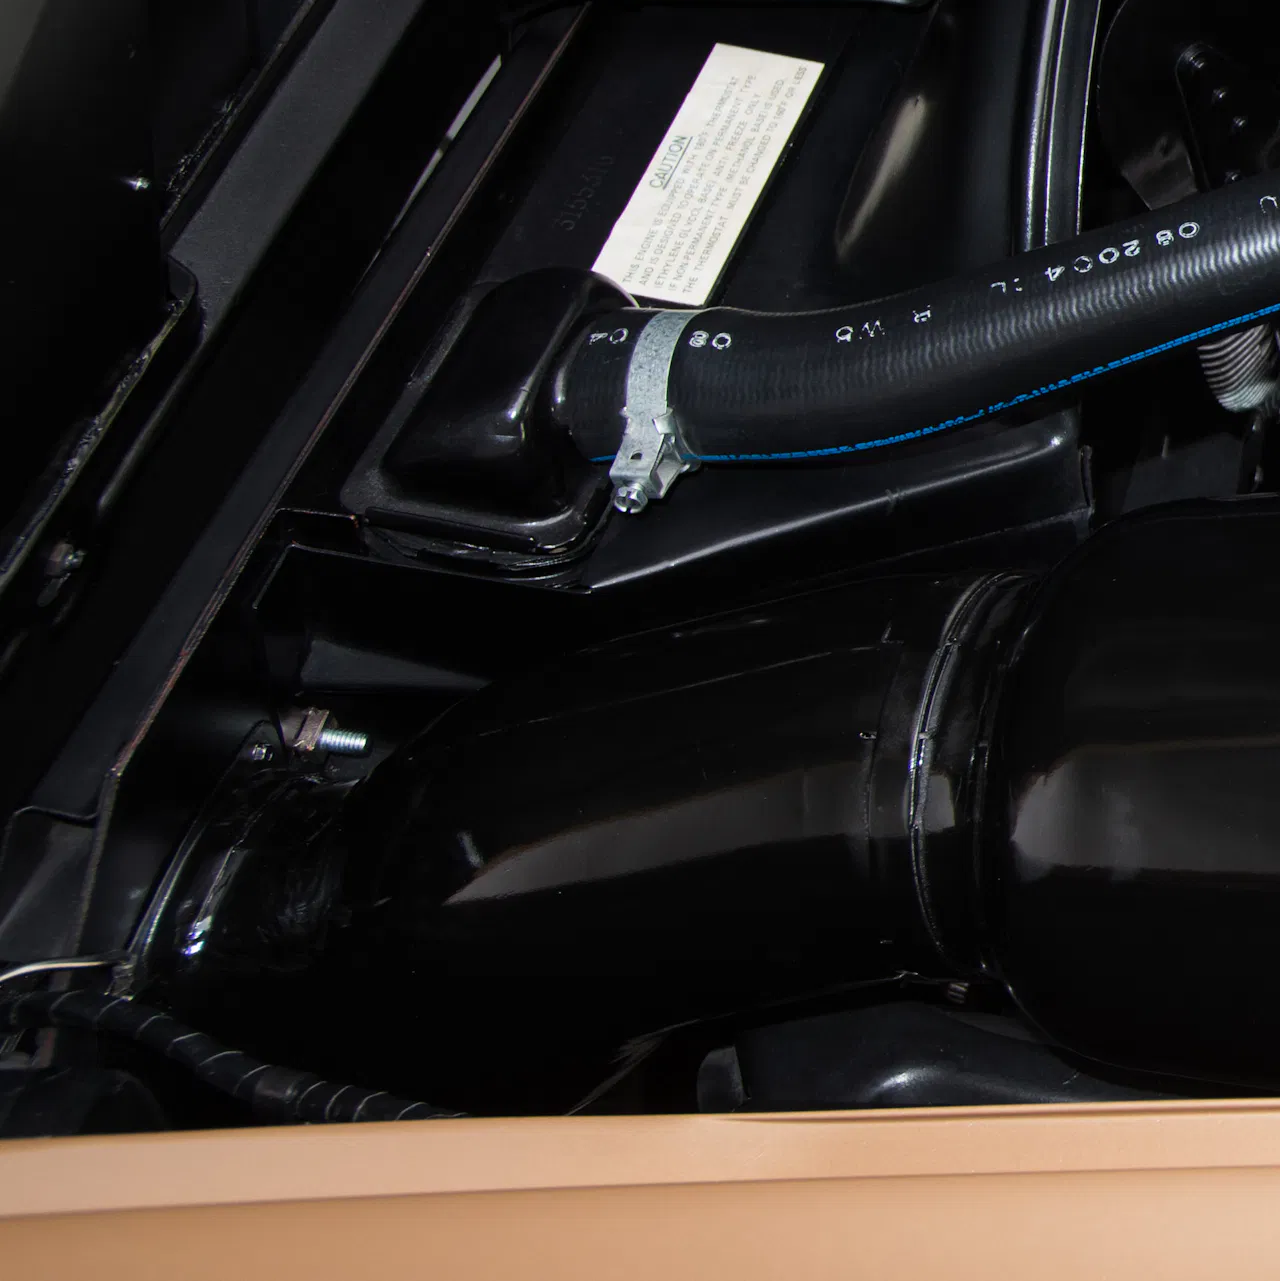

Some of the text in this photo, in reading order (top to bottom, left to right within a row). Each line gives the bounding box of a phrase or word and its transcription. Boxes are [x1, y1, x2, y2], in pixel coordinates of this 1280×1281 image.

[648, 135, 689, 189] CAUTION
[683, 276, 699, 294] THE
[695, 216, 730, 272] THERMOSTAT
[727, 187, 745, 210] MUST
[746, 135, 773, 173] CHANGED
[712, 187, 730, 208] TYPE
[623, 263, 640, 284] THIS
[635, 229, 658, 261] ENGINE
[659, 178, 685, 216] EQUIPPED
[639, 267, 655, 286] AND
[655, 212, 684, 255] DESIGNED
[684, 163, 710, 200] OPERATE
[1154, 221, 1201, 247] 08
[1044, 238, 1141, 283] 2004
[688, 330, 733, 350] 08
